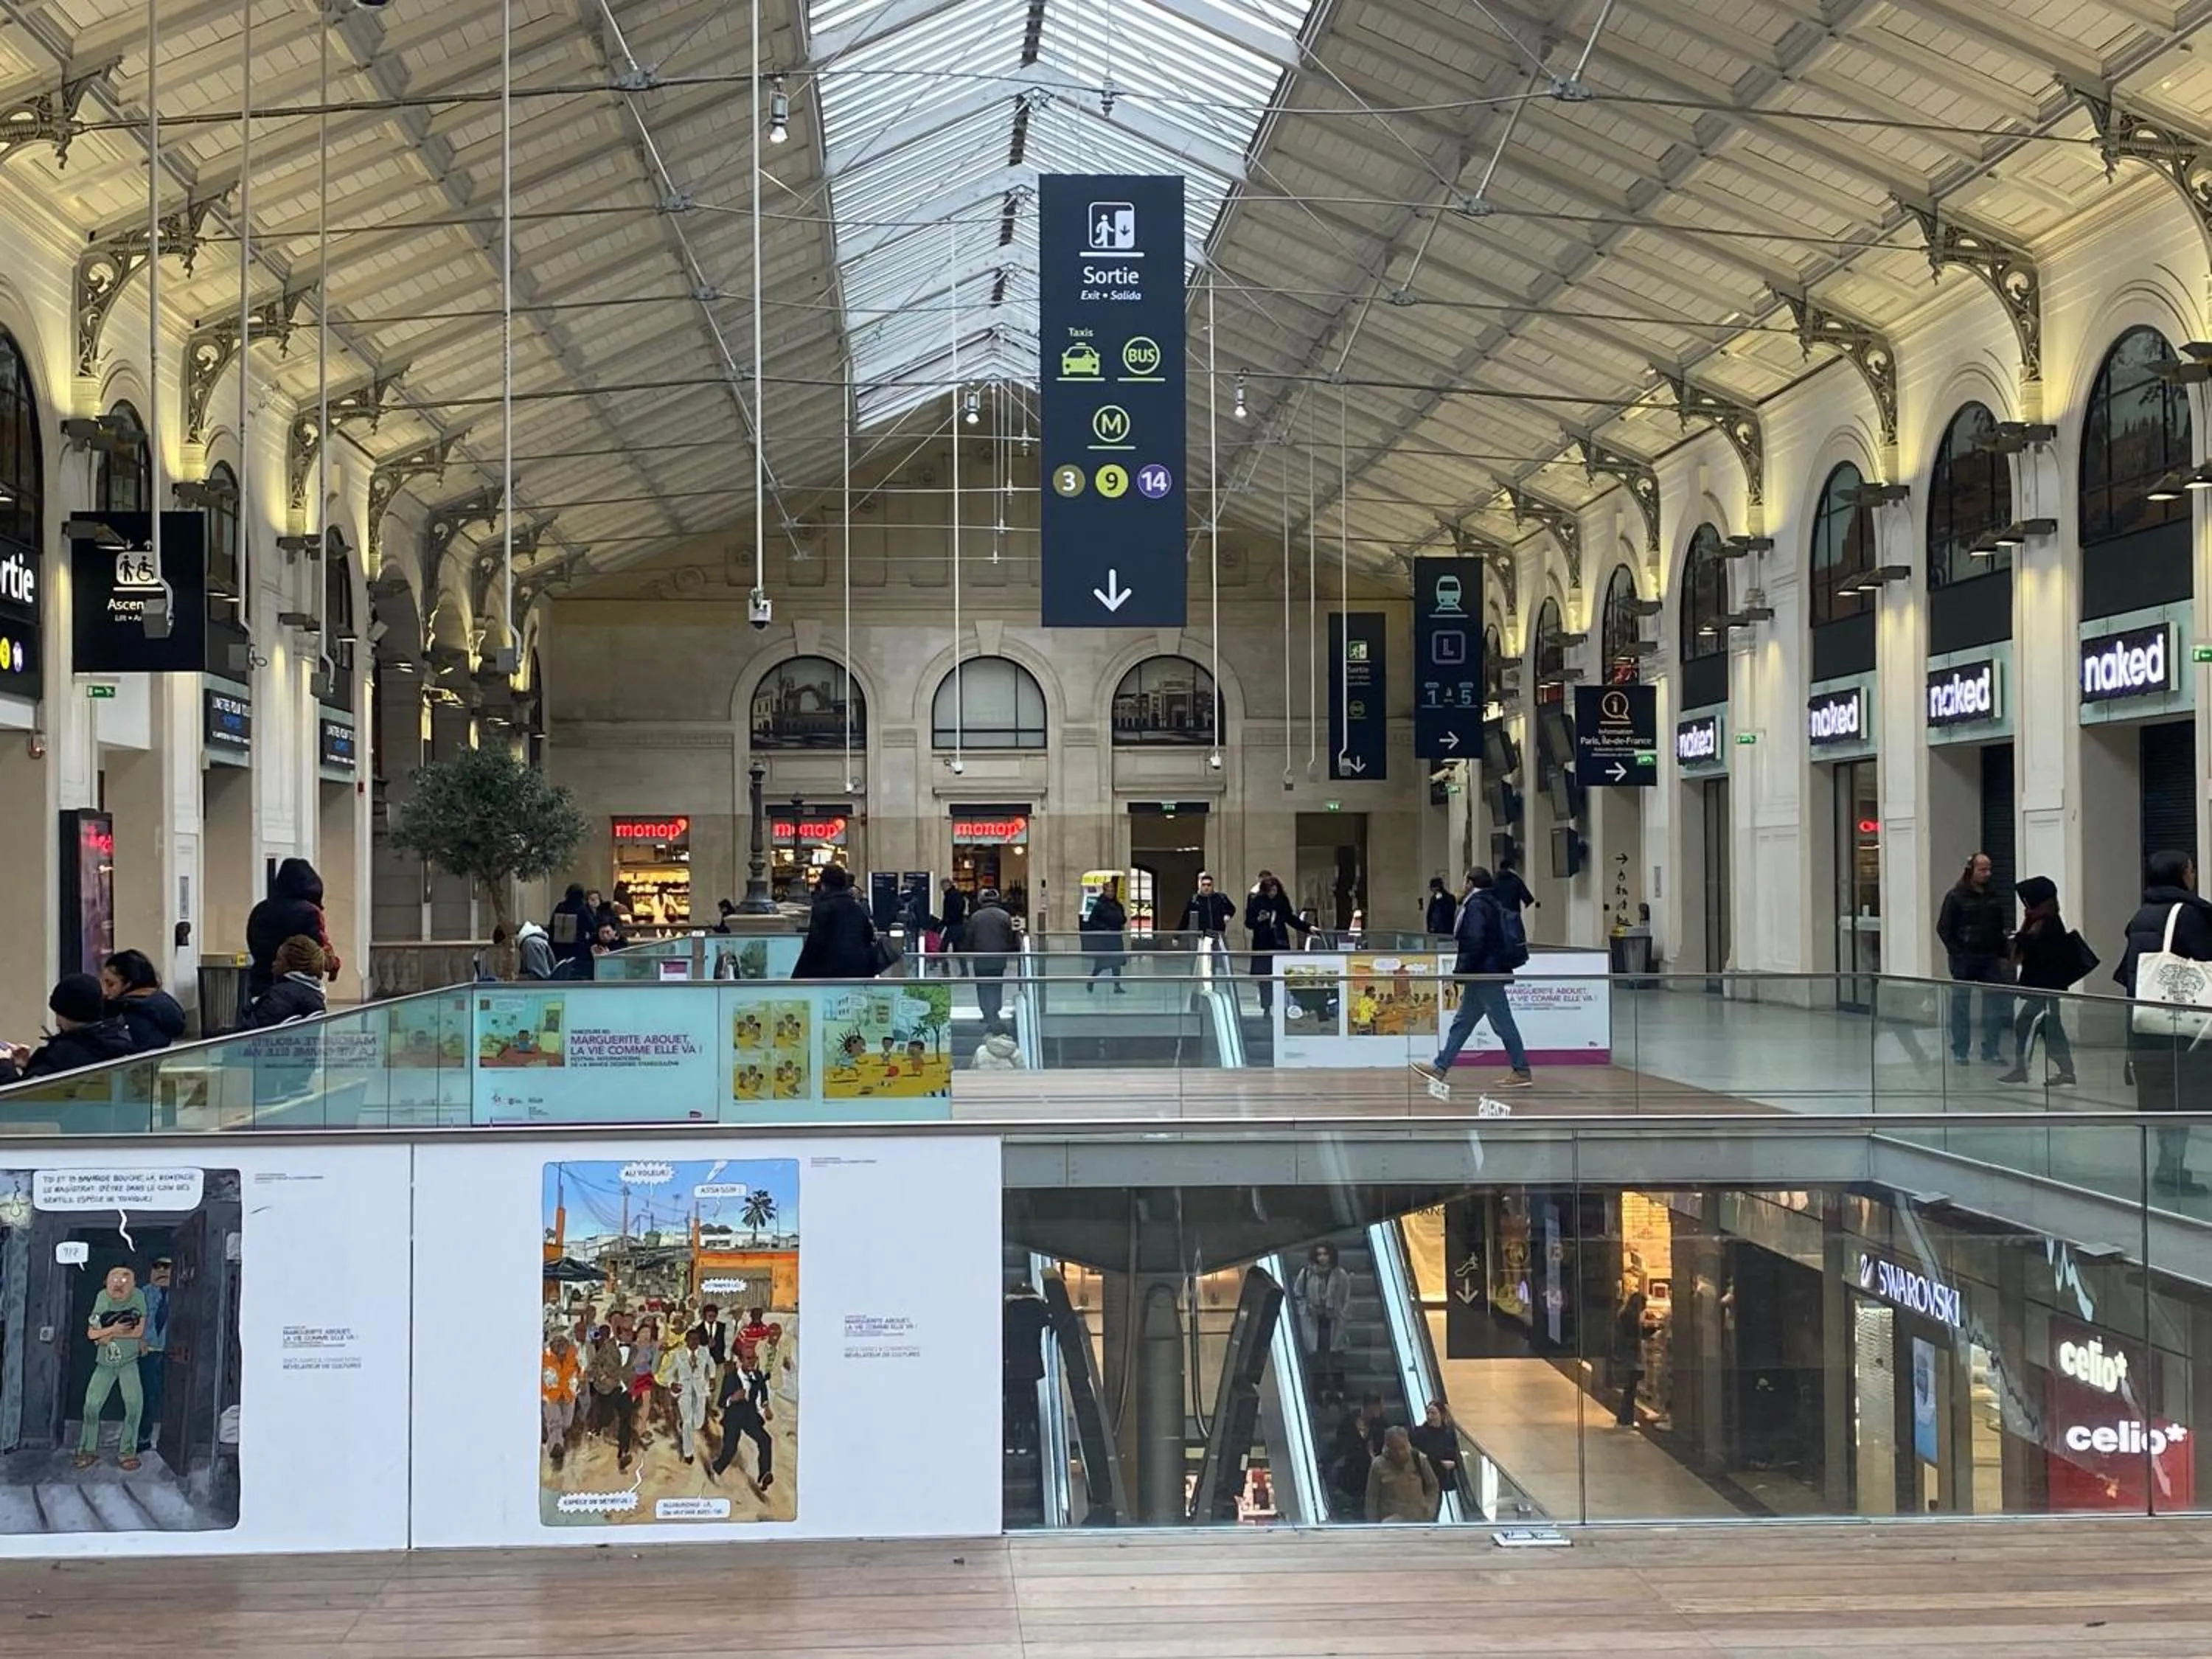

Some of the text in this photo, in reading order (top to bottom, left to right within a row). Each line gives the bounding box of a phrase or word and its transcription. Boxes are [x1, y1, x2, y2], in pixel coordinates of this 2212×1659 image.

[1082, 266, 1140, 285] Sortie
[1080, 290, 1141, 301] Exit Salida
[1068, 327, 1093, 338] Taxis
[1127, 349, 1156, 363] BUS
[1102, 414, 1121, 434] M
[1062, 471, 1076, 491] 3
[1106, 472, 1119, 490] 9
[1141, 471, 1167, 492] 14
[0, 552, 35, 603] rtie
[107, 598, 145, 611] Ascen
[1443, 638, 1455, 656] L
[2084, 633, 2165, 693] naked
[1427, 690, 1436, 705] 1
[1461, 689, 1472, 705] 5
[1930, 667, 1991, 718] naked
[1811, 694, 1859, 738] naked
[1678, 721, 1714, 758] naked
[571, 1034, 641, 1046] MARGUERITE
[571, 1046, 585, 1055] LA
[588, 1046, 605, 1055] VIE
[608, 1045, 650, 1055] COMME
[654, 1045, 678, 1054] ELLE
[681, 1044, 697, 1054] VA
[1878, 1260, 1961, 1328] SWAROVSKI
